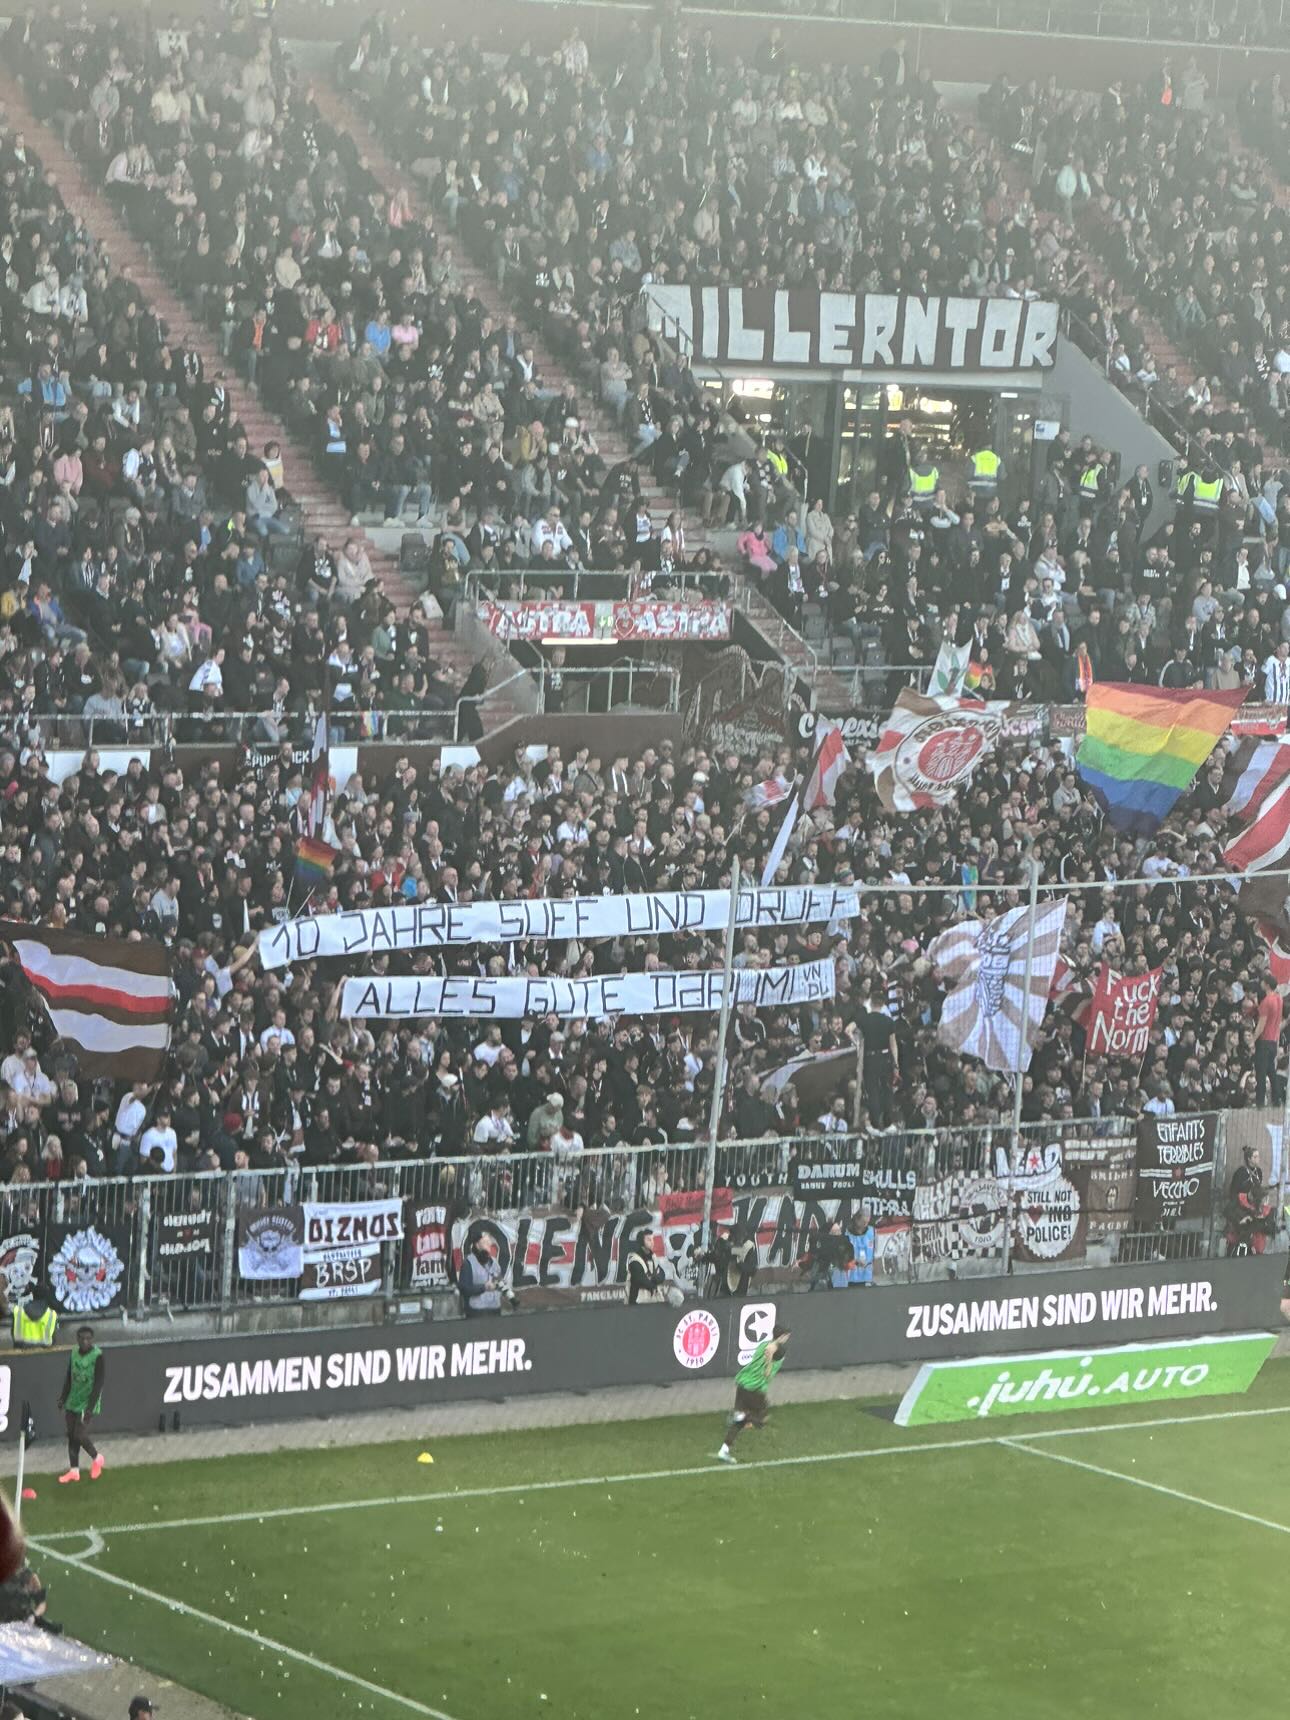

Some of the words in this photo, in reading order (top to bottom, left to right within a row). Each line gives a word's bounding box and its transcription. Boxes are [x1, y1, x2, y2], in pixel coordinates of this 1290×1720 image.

[646, 285, 1059, 367] MILLERNTOR
[496, 609, 591, 636] ASTRA
[637, 606, 730, 635] ASTRA
[272, 920, 320, 959] 10
[341, 903, 473, 953] JAHRE
[499, 899, 599, 937] SUFF
[626, 894, 705, 932] UND
[355, 978, 498, 1014] ALLES
[525, 977, 626, 1016] GUTE
[1106, 968, 1160, 1003] Fuck
[1114, 996, 1151, 1026] the
[1090, 1011, 1150, 1054] Norm
[1157, 1120, 1205, 1142] ENFANTS
[724, 1173, 789, 1188] YOUTH
[797, 1163, 860, 1179] DARUM
[1027, 1191, 1050, 1204] STILL
[1054, 1190, 1072, 1202] NOT
[1026, 1226, 1072, 1243] POLICE!
[315, 1258, 372, 1288] BRSP
[698, 1312, 718, 1337] PAULI
[906, 1297, 1039, 1339] ZUSAMMEN
[1042, 1291, 1097, 1326] SIND
[1100, 1287, 1144, 1322] WIR
[1148, 1281, 1218, 1314] MEHR.
[163, 1356, 322, 1403] ZUSAMMEN
[326, 1349, 392, 1389] SIND
[396, 1344, 446, 1383] WIR
[450, 1338, 533, 1377] MEHR.
